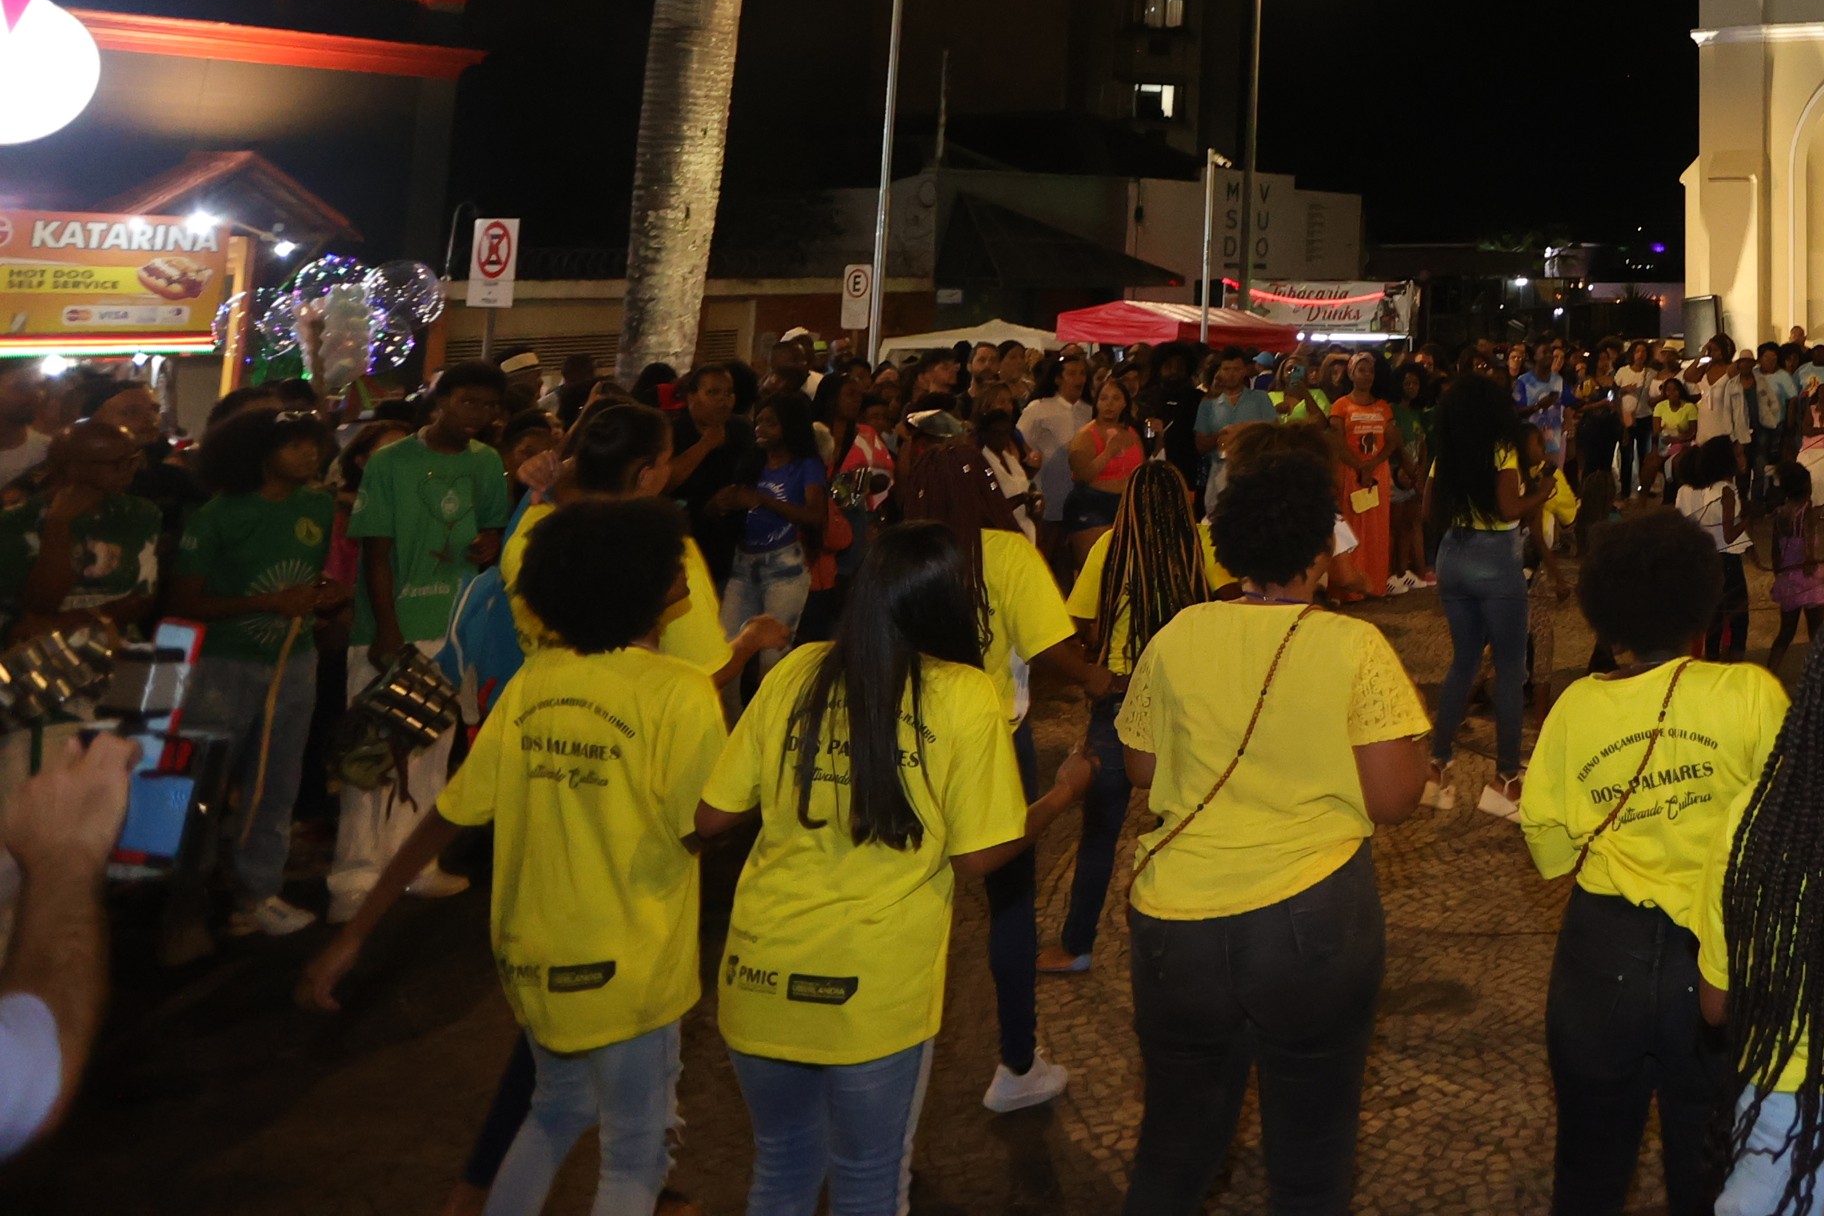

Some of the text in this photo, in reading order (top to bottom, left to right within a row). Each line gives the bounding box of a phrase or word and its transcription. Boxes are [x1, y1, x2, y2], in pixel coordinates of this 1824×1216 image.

[31, 219, 219, 252] KATARINA
[8, 269, 95, 279] HOT DOG
[852, 275, 862, 292] E
[7, 280, 119, 290] SELF SERVICE
[1299, 303, 1362, 322] Drinks
[1577, 728, 1718, 782] TERNO MOÇAMBIQE QUILOMBO
[1591, 761, 1714, 804] DOS PALMARES
[739, 966, 779, 987] PMIC
